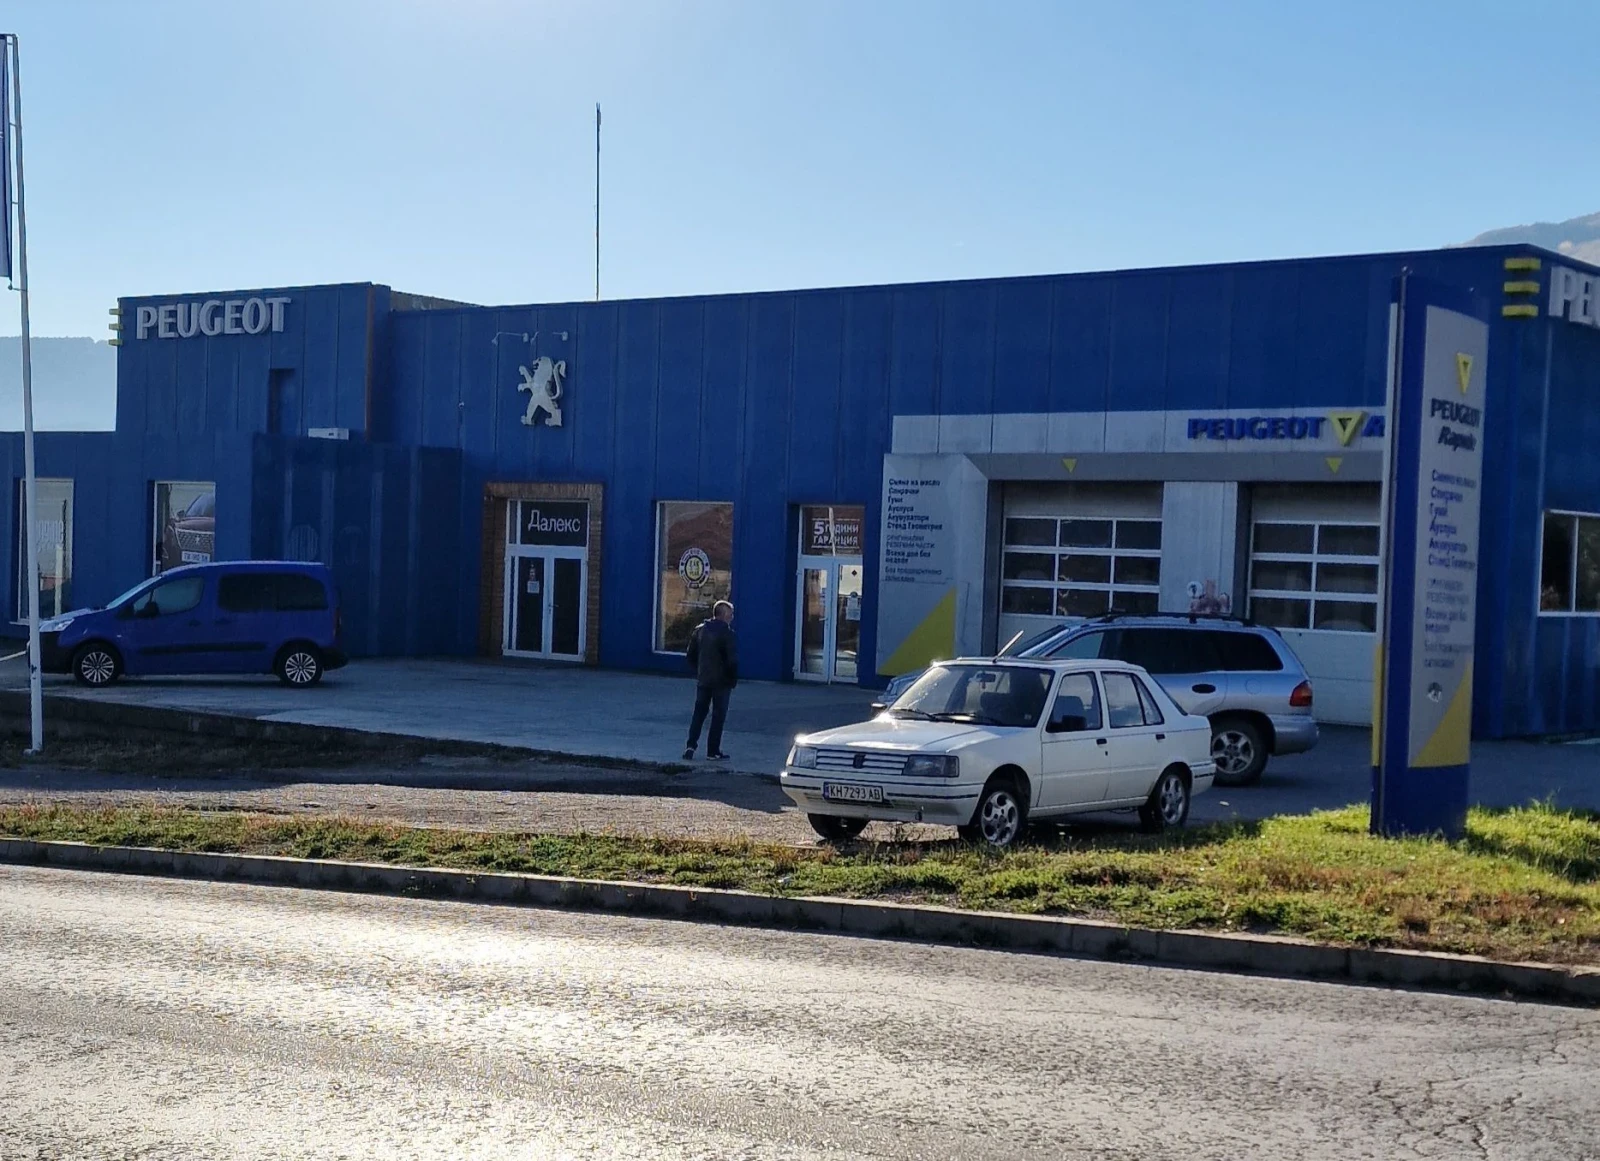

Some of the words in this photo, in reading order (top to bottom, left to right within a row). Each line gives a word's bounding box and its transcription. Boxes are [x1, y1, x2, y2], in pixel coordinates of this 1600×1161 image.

[136, 297, 292, 340] PEUGEOT
[1187, 416, 1326, 441] PEUGEOT
[528, 509, 581, 533] Далекс
[814, 521, 825, 535] 5
[825, 523, 859, 534] ГДИНИ
[813, 535, 858, 546] ГАРАНЦИЯ
